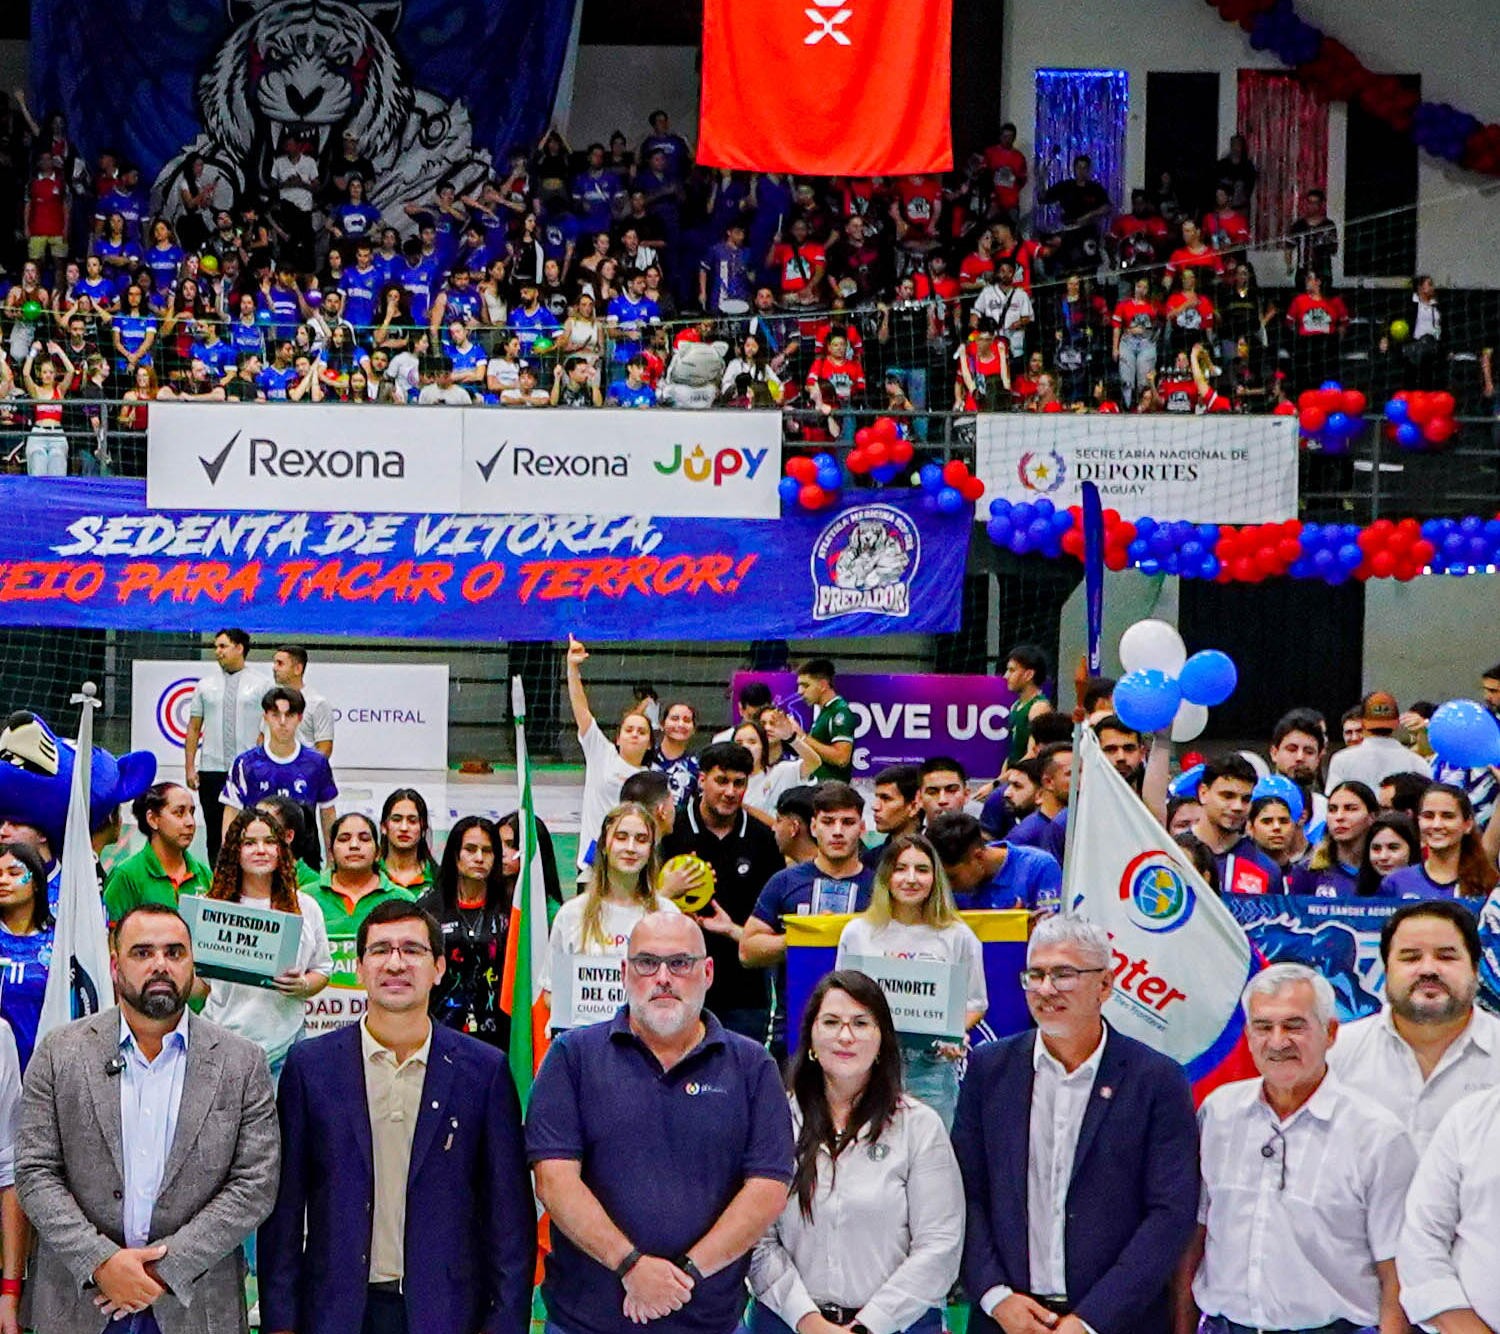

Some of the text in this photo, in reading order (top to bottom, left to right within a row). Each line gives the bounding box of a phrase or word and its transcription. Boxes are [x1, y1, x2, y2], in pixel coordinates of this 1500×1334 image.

[248, 437, 405, 480] Rexona
[514, 447, 628, 477] Rexona
[1074, 449, 1249, 462] SECRETARÍA NACIONAL DE
[1074, 463, 1199, 483] DEPORTES
[50, 513, 312, 559] SEDENTA
[308, 513, 409, 556] DE
[115, 562, 258, 604] PARA
[276, 559, 448, 604] TACAR
[461, 559, 503, 603] O
[514, 553, 759, 604] TERROR!
[818, 582, 906, 614] PREDADOR
[347, 708, 426, 724] CENTRAL
[814, 703, 930, 740] OVE
[202, 909, 280, 934] UNIVERSIDAD
[217, 929, 260, 948] LA PAZ
[198, 940, 275, 961] CIUDAD DEL ESTE
[582, 987, 604, 1001] DEL
[577, 1004, 613, 1013] CIUDAD
[904, 1008, 920, 1017] DEL
[923, 1009, 944, 1019] ESTE
